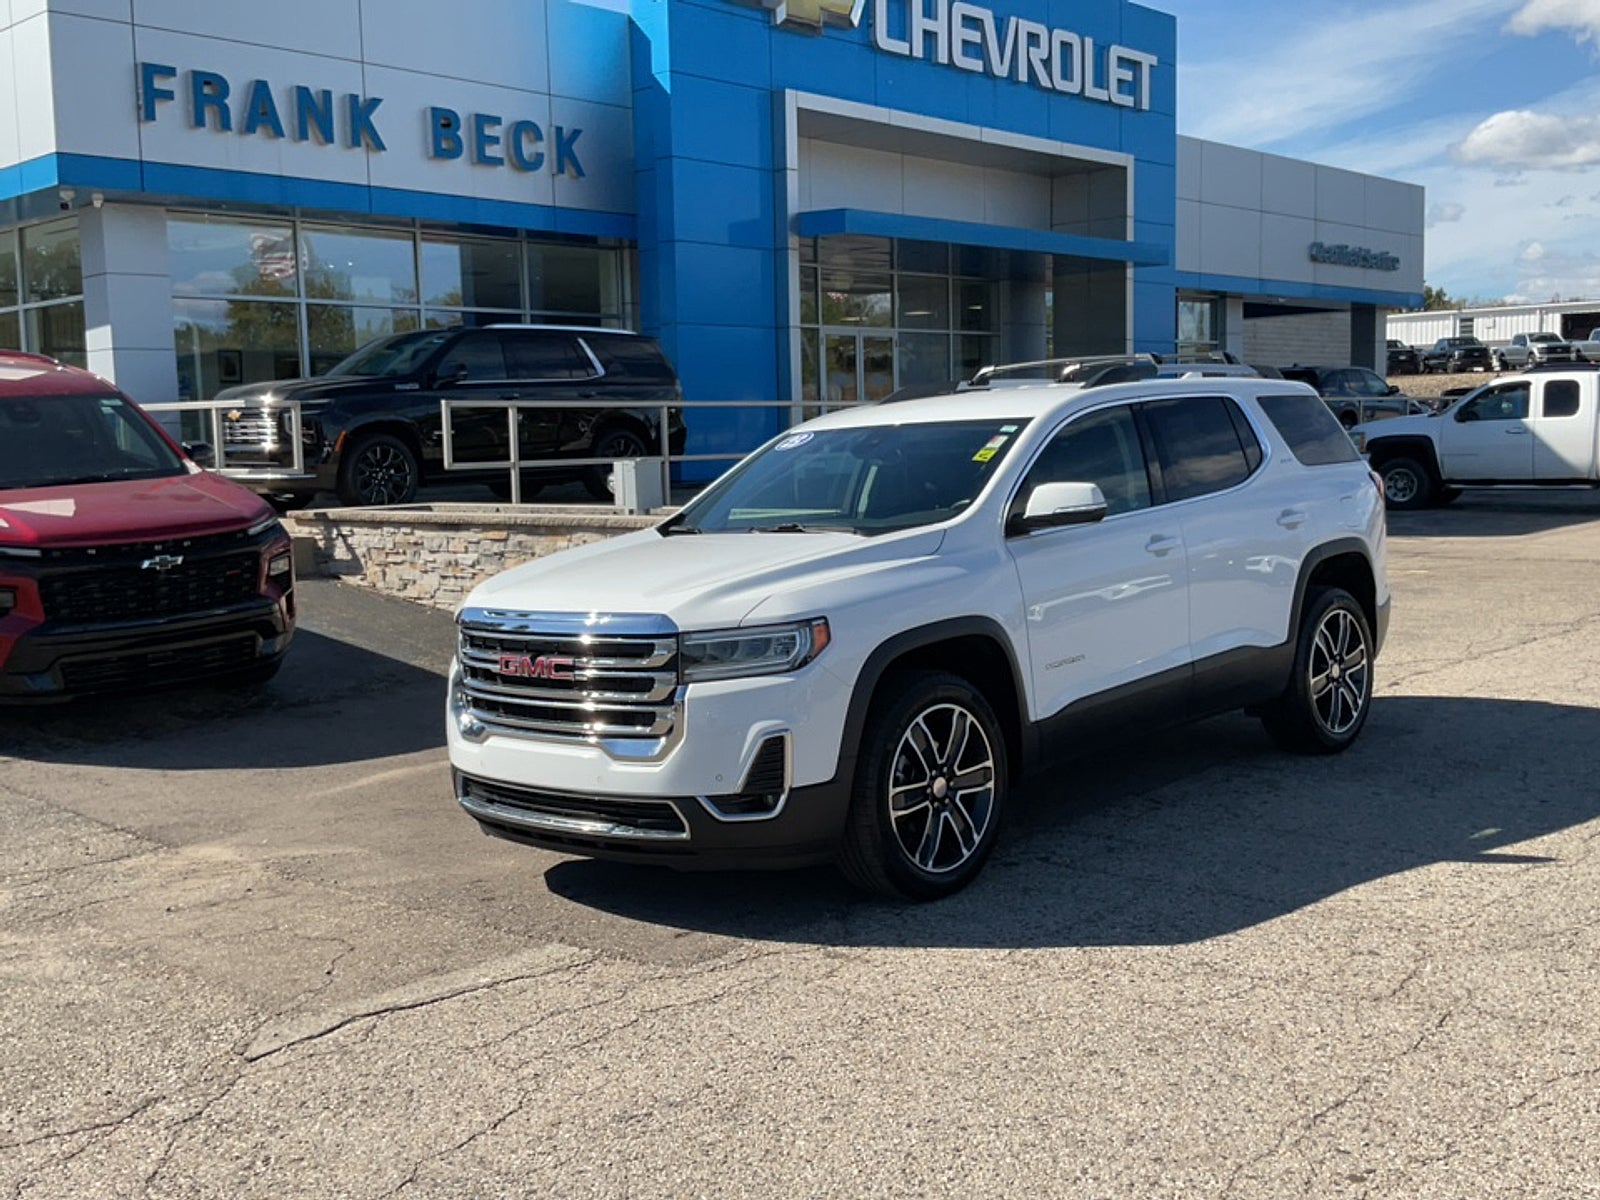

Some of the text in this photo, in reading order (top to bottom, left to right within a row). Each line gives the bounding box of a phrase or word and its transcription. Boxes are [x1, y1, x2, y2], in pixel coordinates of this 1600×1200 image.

[874, 0, 1158, 110] CHEVROLET
[138, 62, 586, 179] FRANK BECK
[499, 654, 574, 680] GMC
